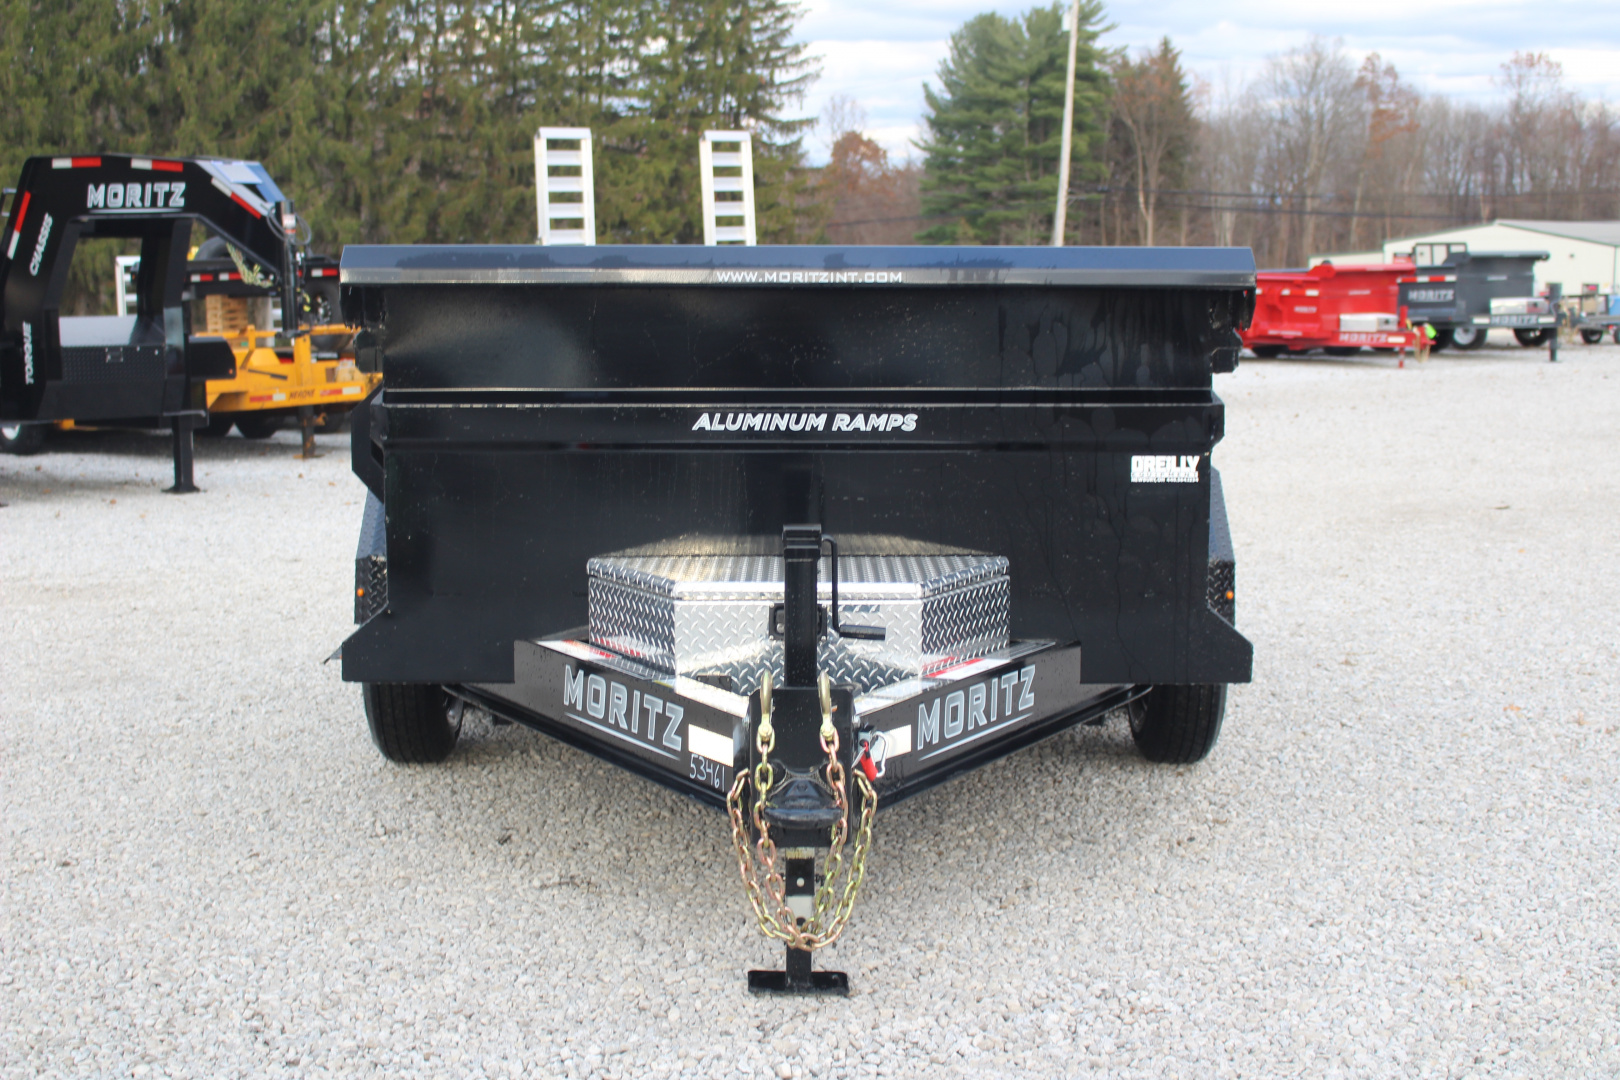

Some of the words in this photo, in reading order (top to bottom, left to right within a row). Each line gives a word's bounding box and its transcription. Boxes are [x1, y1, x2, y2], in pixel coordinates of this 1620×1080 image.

[87, 182, 186, 209] MORITZ
[29, 212, 53, 276] CHASSIS
[716, 271, 902, 284] WWW.MORITZINT.COM
[22, 321, 34, 385] TORQUE
[692, 413, 827, 431] ALUMINUM
[832, 413, 918, 431] RAMPS
[563, 664, 684, 752] MORITZ
[917, 664, 1036, 751] MORITZ
[690, 753, 725, 793] 53461
